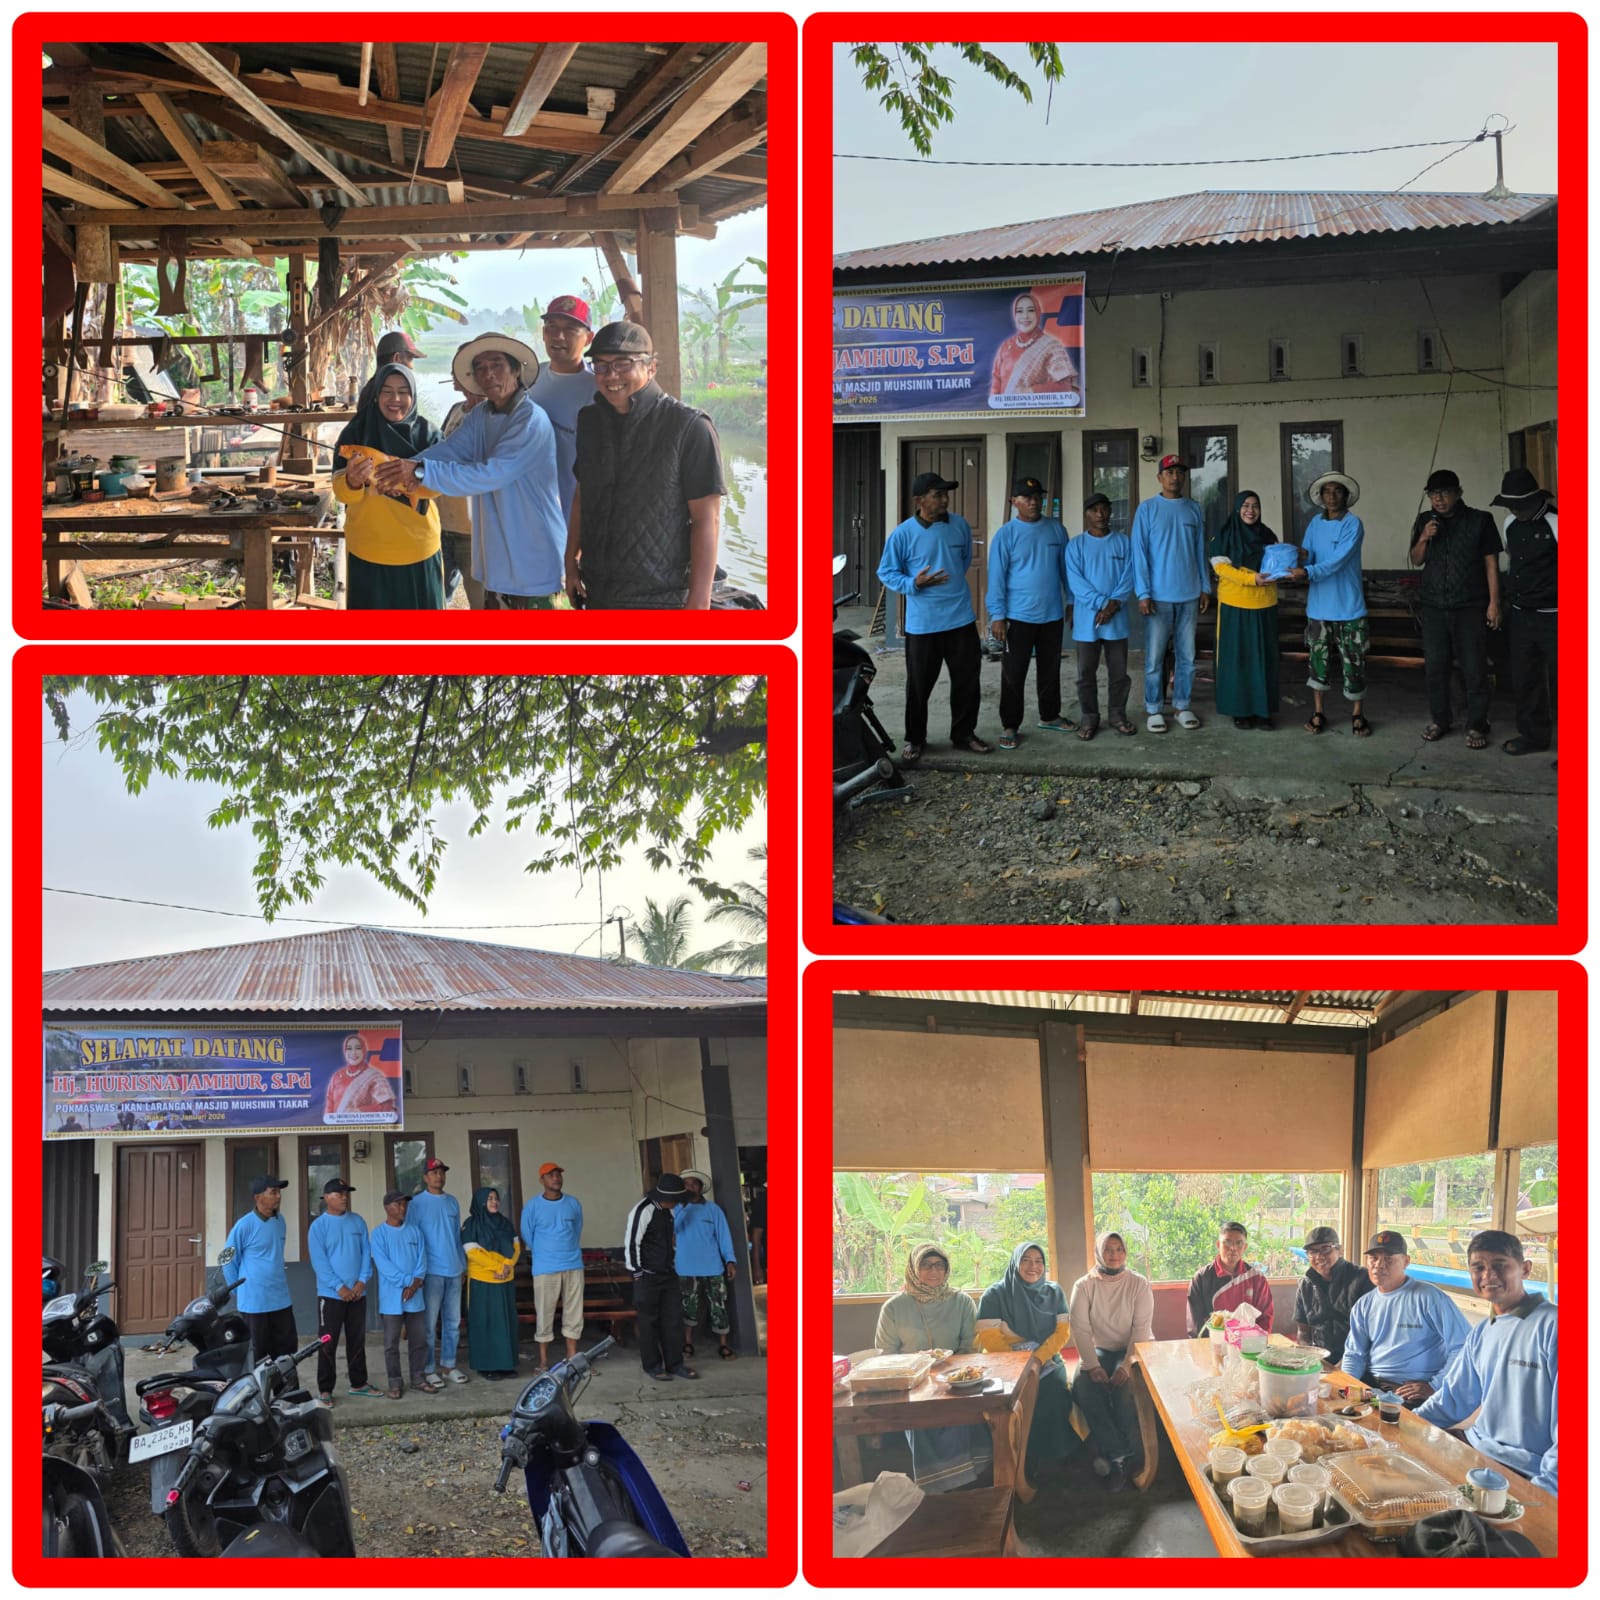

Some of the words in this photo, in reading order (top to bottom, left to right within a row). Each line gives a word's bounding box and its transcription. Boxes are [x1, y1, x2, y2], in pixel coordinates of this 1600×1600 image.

[842, 301, 945, 335] DATANG
[928, 344, 975, 366] S.Pd
[845, 381, 881, 392] MASJID
[884, 379, 933, 391] MUHSININ
[936, 378, 971, 389] TIAKAR
[80, 1038, 185, 1066] SELAMAT
[192, 1037, 285, 1064] DATANG
[53, 1075, 81, 1096] Hj.
[85, 1074, 178, 1092] HURISNA
[180, 1073, 268, 1094] JAMHUR,
[271, 1071, 312, 1089] S.Pd
[121, 1102, 143, 1112] IKAN
[145, 1101, 192, 1111] LARANGAN
[195, 1101, 229, 1111] MASJID
[231, 1100, 276, 1110] MUHSININ
[278, 1099, 309, 1109] TIAKAR
[134, 1437, 146, 1449] BA
[178, 1422, 191, 1435] MS
